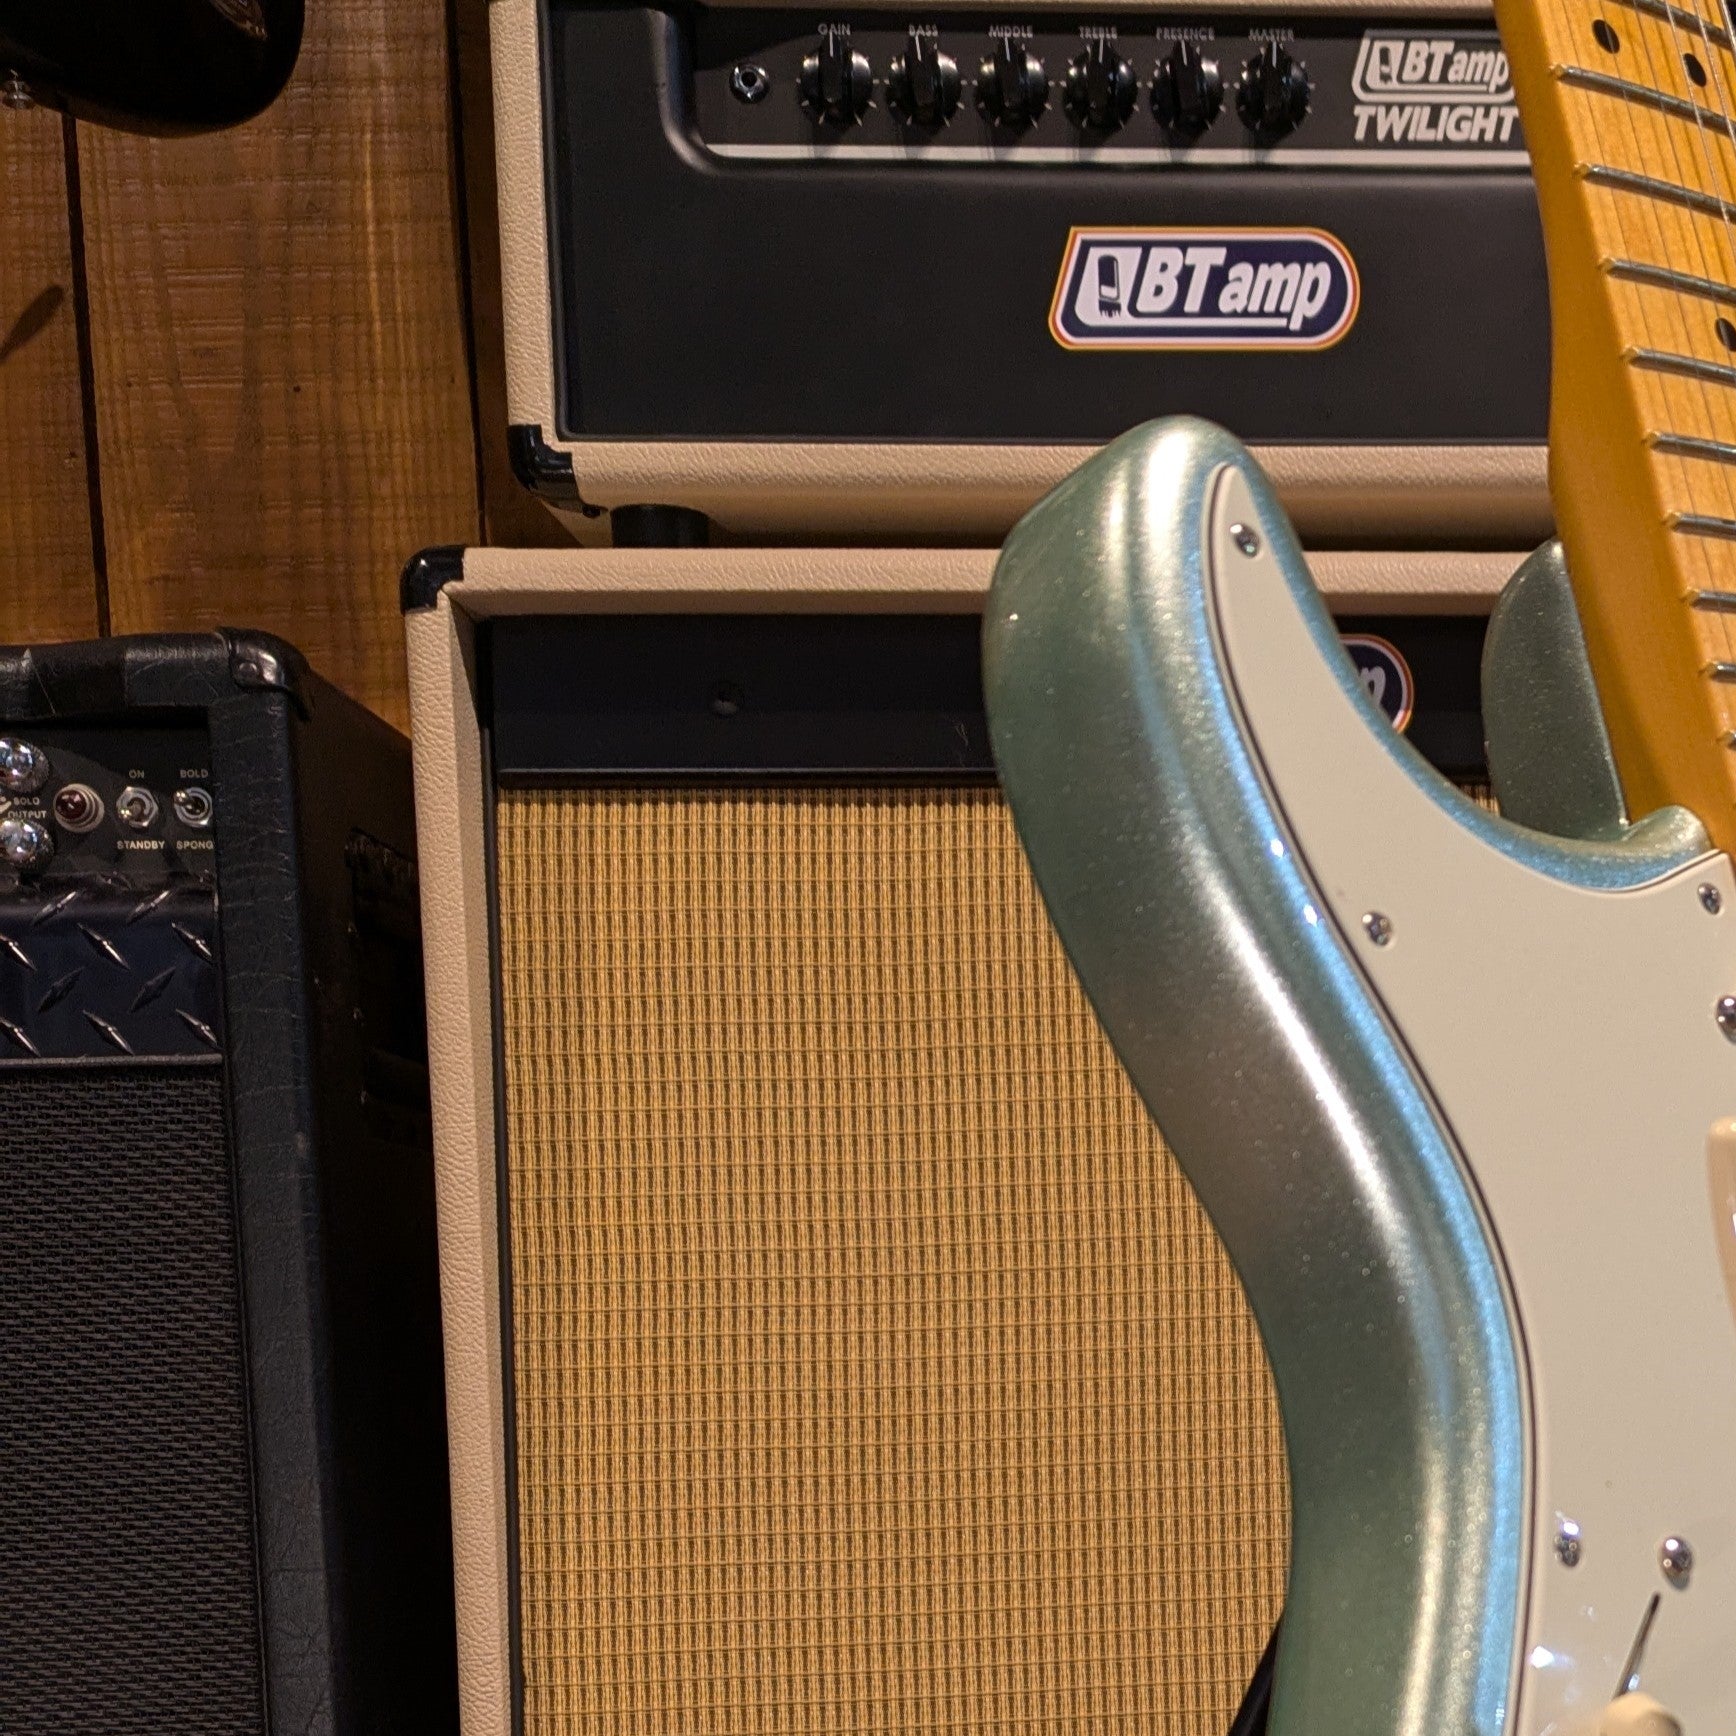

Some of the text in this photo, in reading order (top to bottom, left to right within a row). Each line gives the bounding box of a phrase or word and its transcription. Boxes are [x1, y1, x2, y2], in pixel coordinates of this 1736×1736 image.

[817, 23, 1295, 41] GAIN BASS MIDDLE TREBLE PRESENCE MASTER
[1401, 40, 1510, 93] BT amp
[1353, 105, 1520, 142] TWILIGHT
[1136, 246, 1332, 331] BT amp
[128, 769, 145, 779] ON
[179, 769, 209, 779] BOLD
[7, 810, 47, 819] OUTPUT
[116, 840, 166, 850] STANDBY
